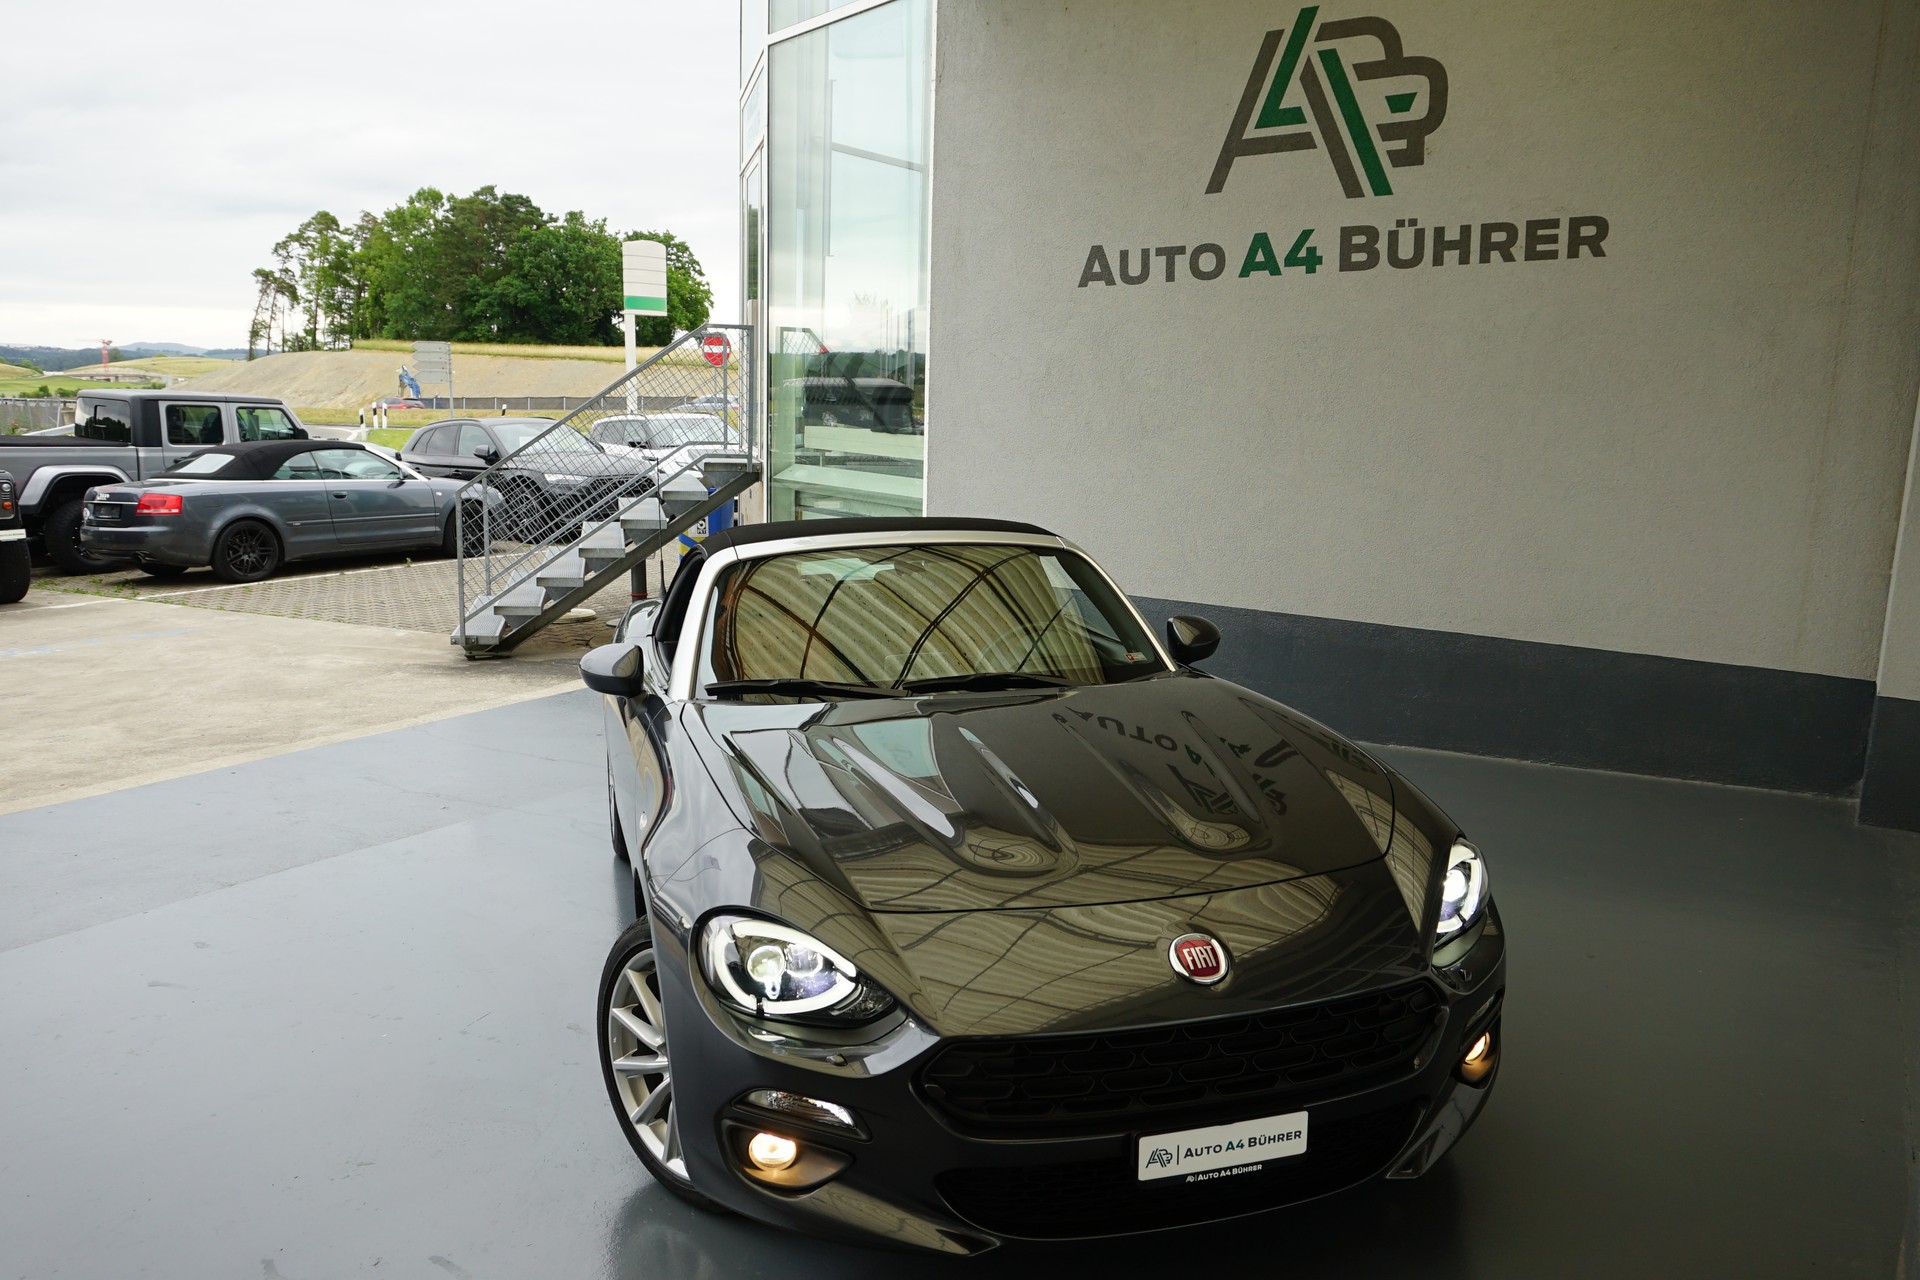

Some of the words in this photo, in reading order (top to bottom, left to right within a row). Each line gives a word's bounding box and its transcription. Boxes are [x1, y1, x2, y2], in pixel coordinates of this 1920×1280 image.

[1077, 243, 1226, 288] AUTO
[1238, 229, 1323, 278] A4
[1338, 215, 1610, 272] BÜHRER
[1182, 945, 1217, 970] FIAT
[1184, 1144, 1222, 1159] AUTO
[1225, 1139, 1245, 1152] A4
[1248, 1130, 1302, 1148] BÜHRER
[1198, 1172, 1219, 1181] AUTO
[1220, 1169, 1231, 1177] A4
[1232, 1164, 1263, 1175] BÜHRER
